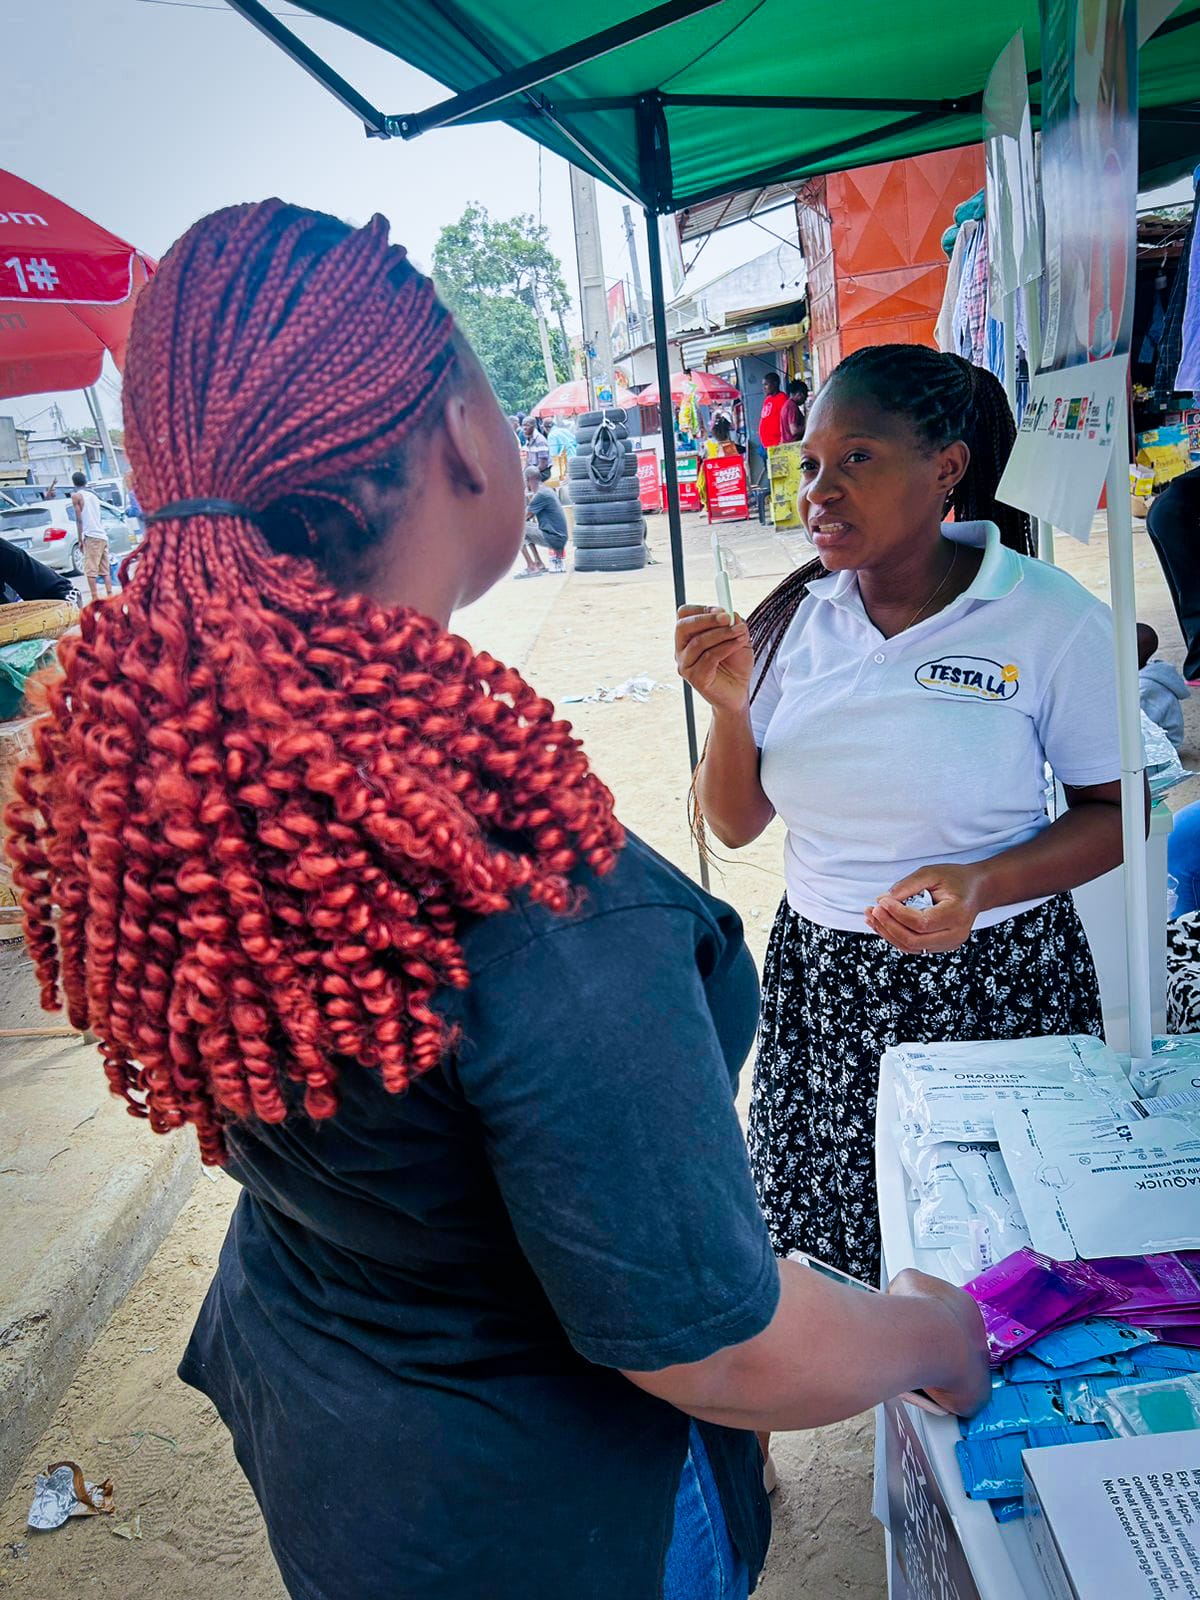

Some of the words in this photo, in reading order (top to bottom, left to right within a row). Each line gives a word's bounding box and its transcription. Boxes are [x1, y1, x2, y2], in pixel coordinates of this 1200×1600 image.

[930, 664, 983, 688] TESTA
[1102, 1479, 1117, 1495] Not
[1117, 1477, 1131, 1487] of
[1110, 1495, 1121, 1505] to
[1122, 1487, 1138, 1506] heat
[1147, 1474, 1164, 1497] Store
[1159, 1498, 1170, 1507] in
[1165, 1508, 1182, 1526] well
[1115, 1506, 1138, 1537] exceed
[1132, 1475, 1160, 1520] conditions
[1155, 1521, 1173, 1544] away
[1168, 1546, 1185, 1568] from
[1132, 1507, 1158, 1548] including
[1130, 1538, 1154, 1576] average
